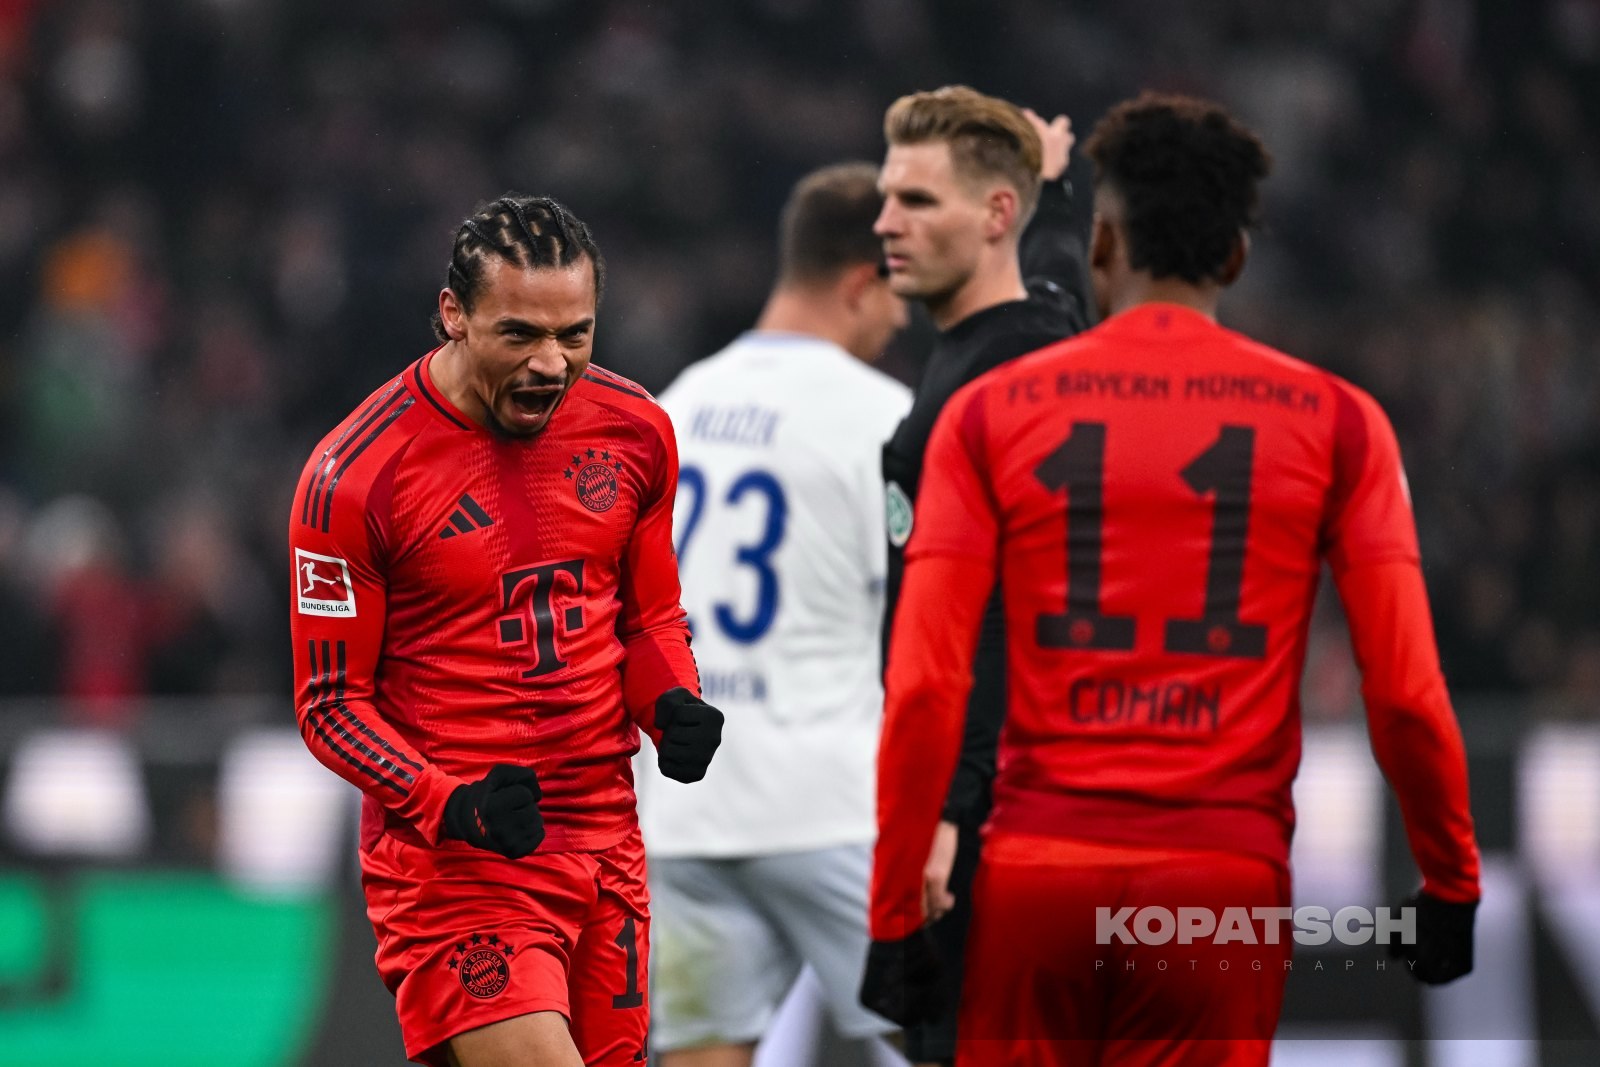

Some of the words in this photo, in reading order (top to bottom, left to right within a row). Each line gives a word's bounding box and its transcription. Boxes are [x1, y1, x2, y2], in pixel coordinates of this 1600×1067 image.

[1006, 375, 1041, 405] FC
[1056, 370, 1170, 400] BAYERN
[579, 474, 587, 487] FC
[585, 465, 614, 483] BAYERN
[1033, 421, 1268, 659] 11
[300, 601, 350, 612] BUNDESLIGA
[1069, 678, 1221, 731] COMAN
[463, 963, 471, 974] FC
[469, 952, 503, 968] BAYERN
